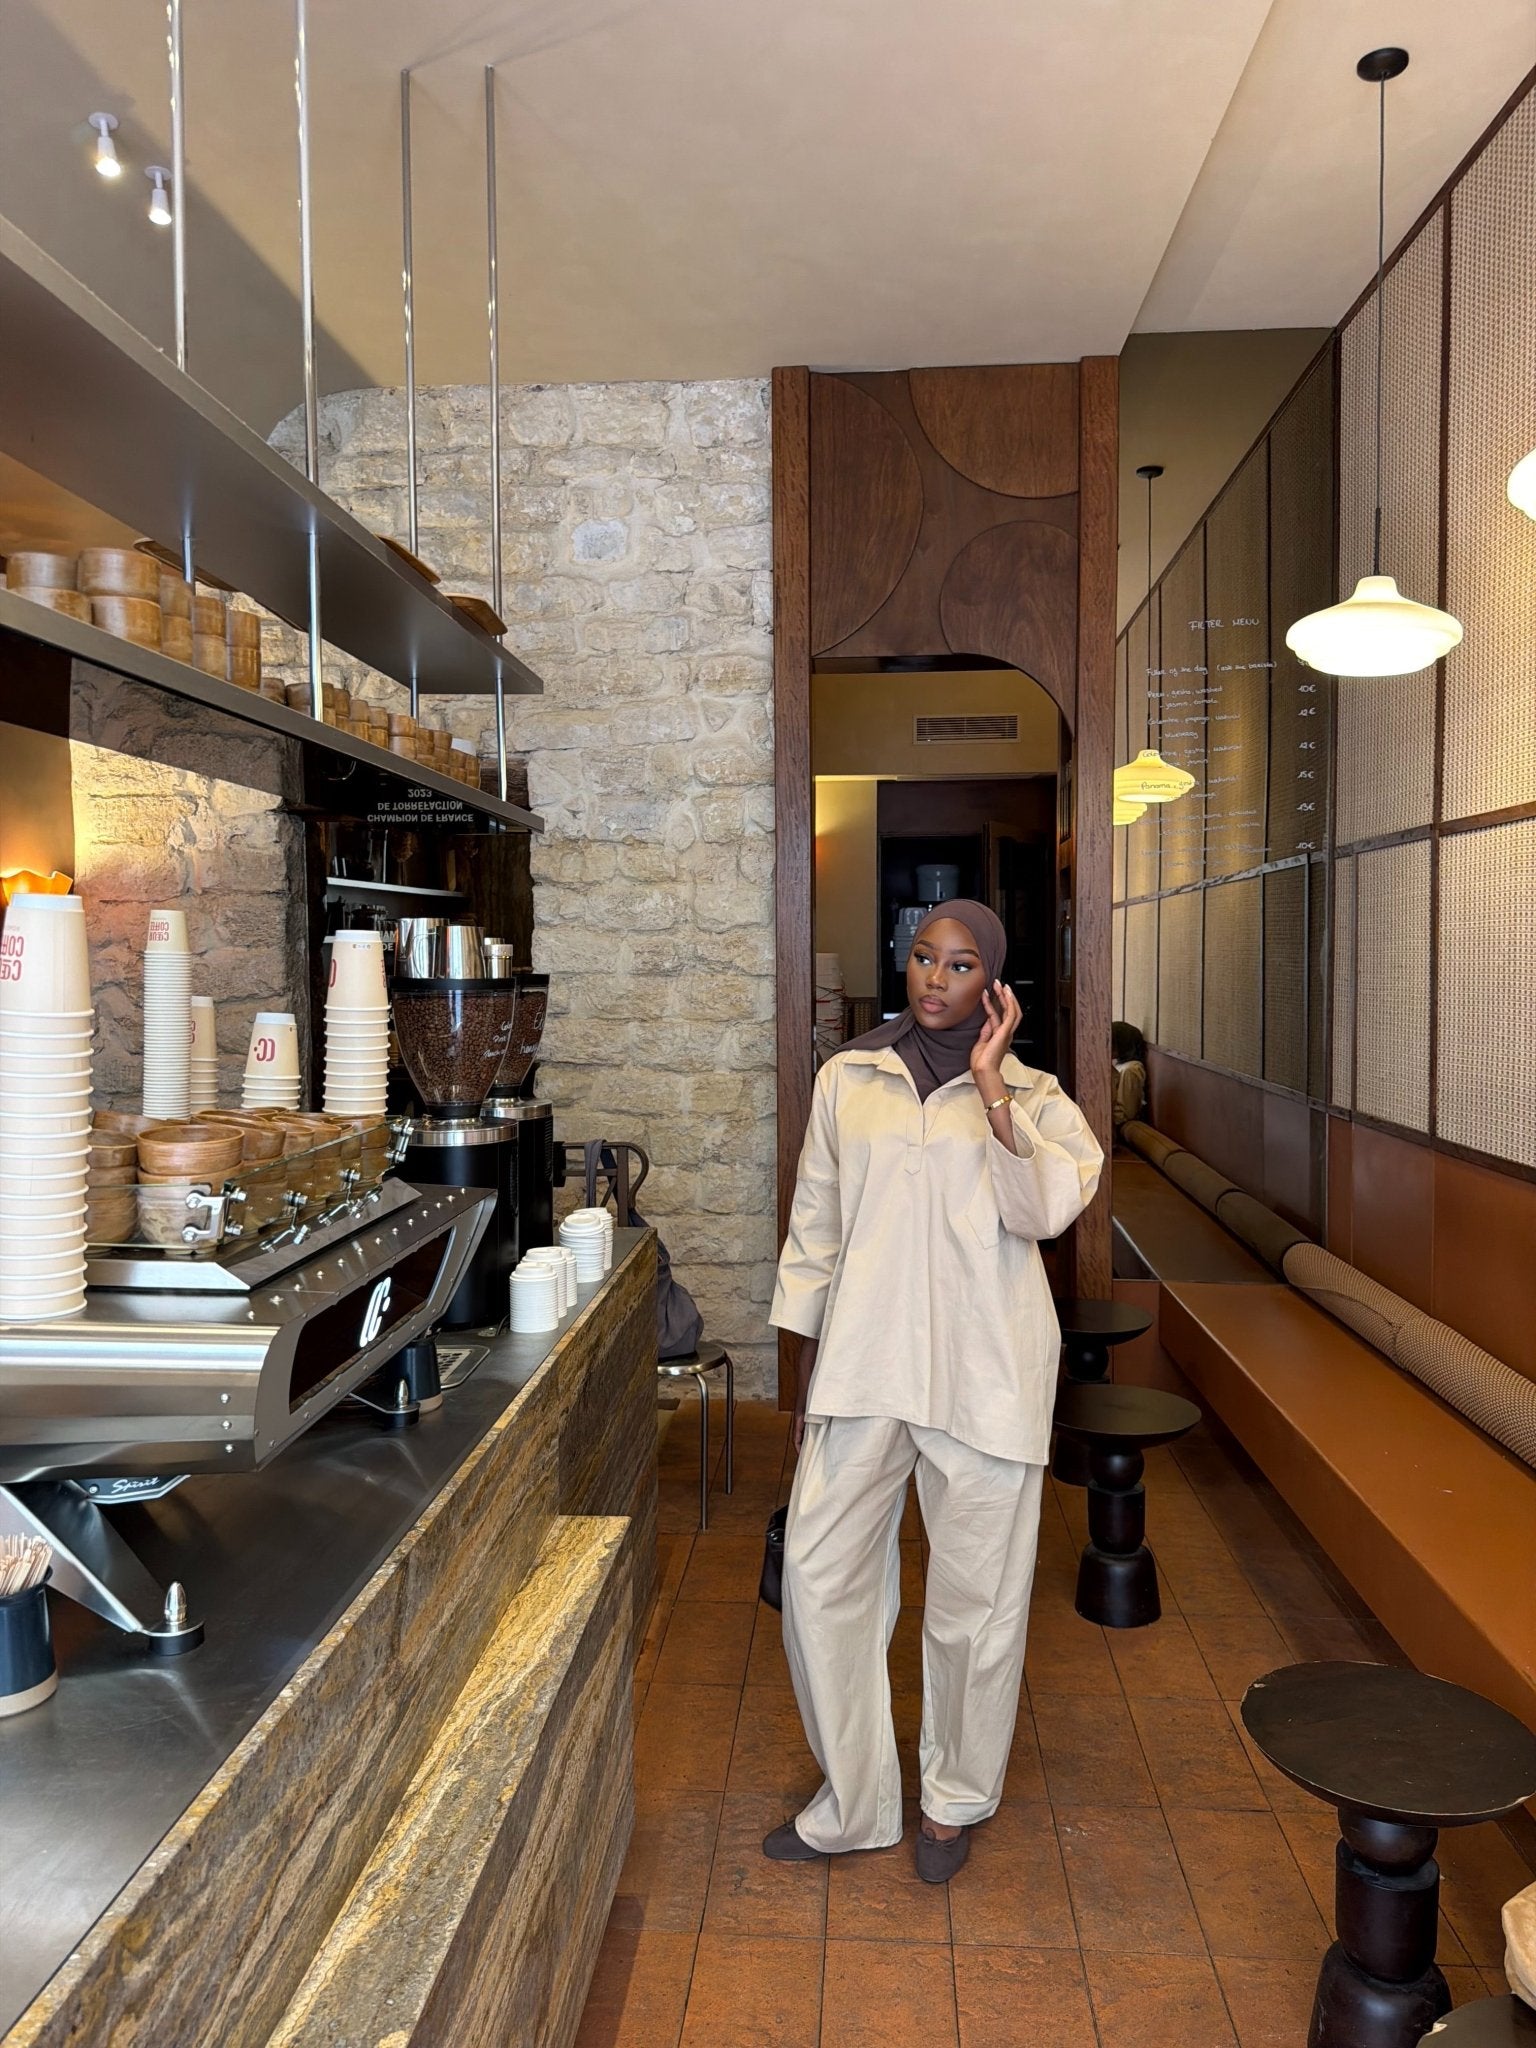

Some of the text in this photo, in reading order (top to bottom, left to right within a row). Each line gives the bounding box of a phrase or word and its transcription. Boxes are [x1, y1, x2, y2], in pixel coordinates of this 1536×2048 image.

[1188, 618, 1260, 631] FILTER MENU
[1193, 664, 1209, 675] day
[111, 1476, 160, 1494] Spirit
